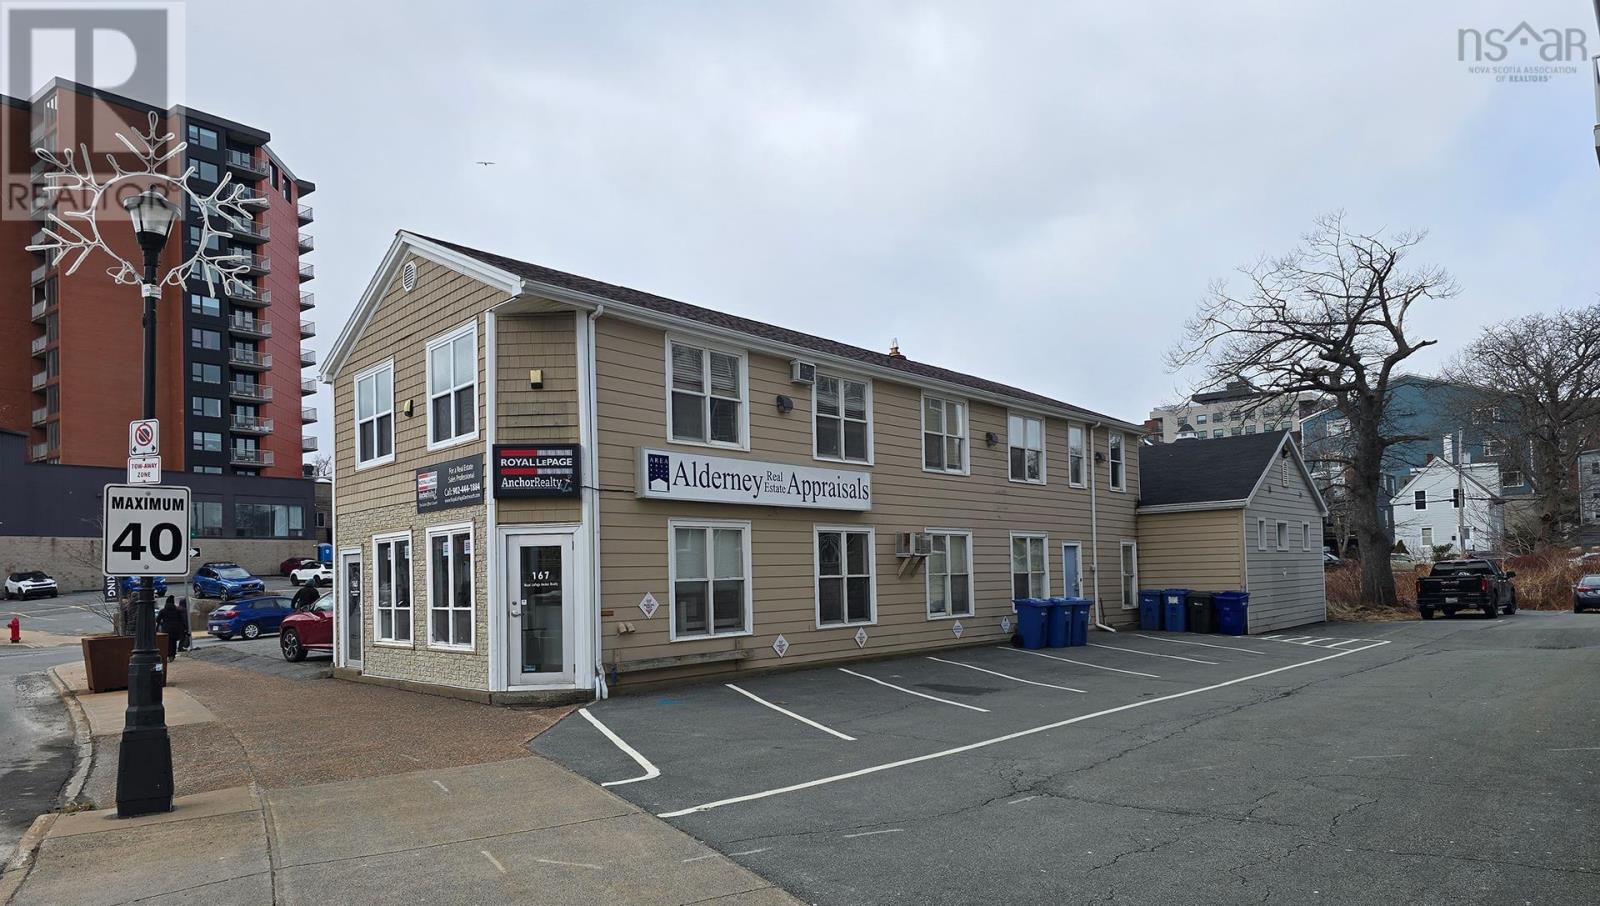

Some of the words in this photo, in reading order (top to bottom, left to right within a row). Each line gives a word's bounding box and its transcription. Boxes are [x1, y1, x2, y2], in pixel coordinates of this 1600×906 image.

[463, 464, 474, 472] Estate
[500, 458, 535, 467] ROYAL
[456, 471, 475, 481] Professional
[672, 460, 764, 499] Alderney
[766, 470, 784, 482] Real
[501, 476, 562, 489] AnchorRealty
[787, 472, 869, 503] Appraisals
[764, 483, 786, 495] Estate
[112, 496, 185, 511] MAXIMUM
[112, 522, 183, 562] 40
[532, 570, 550, 580] 167
